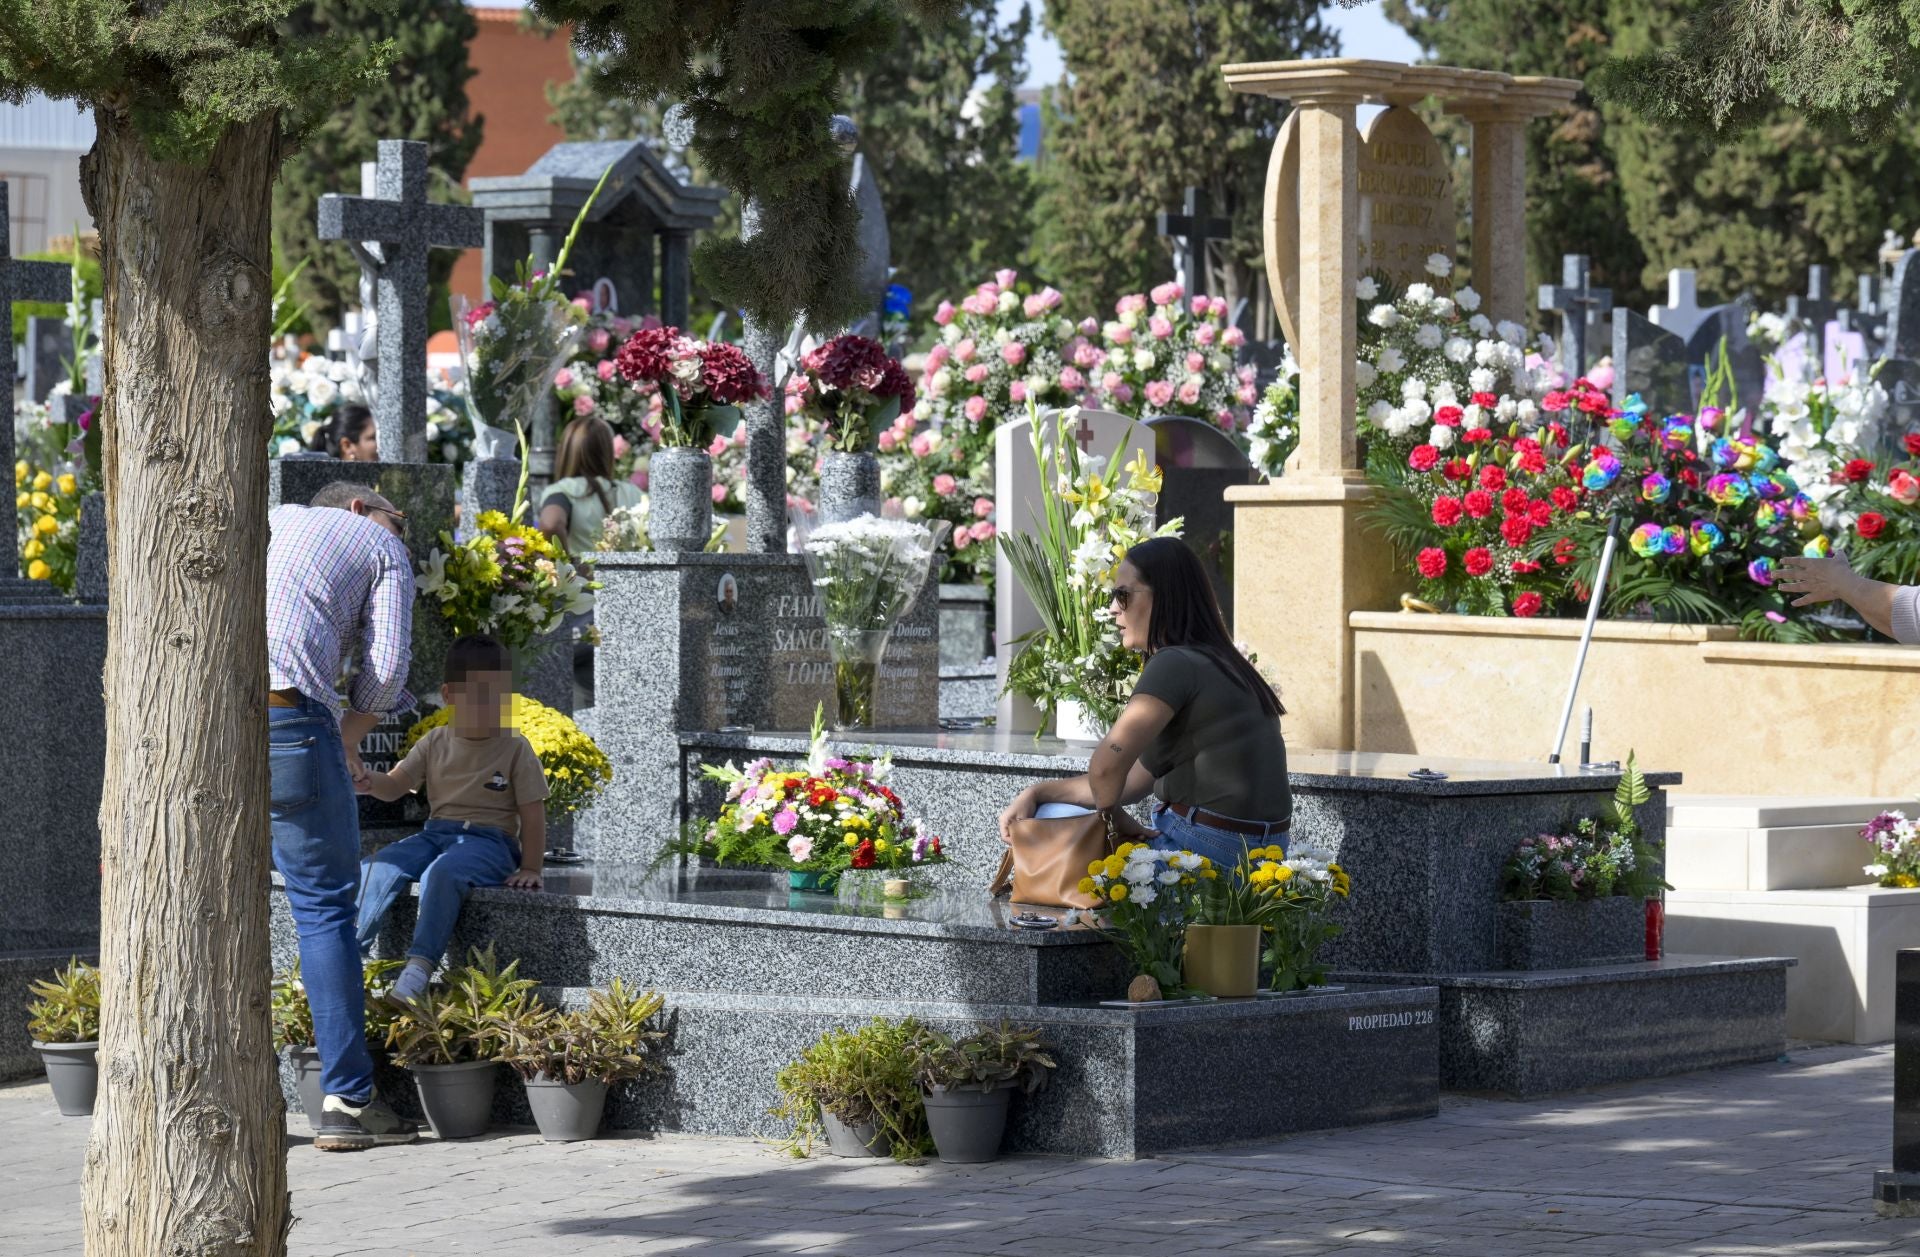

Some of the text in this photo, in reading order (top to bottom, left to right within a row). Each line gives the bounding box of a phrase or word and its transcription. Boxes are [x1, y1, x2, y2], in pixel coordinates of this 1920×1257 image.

[778, 595, 827, 617] FAMI
[773, 623, 832, 651] SÁNC
[897, 623, 932, 637] Dolores
[1348, 1009, 1433, 1031] PROPIEDAD 228
